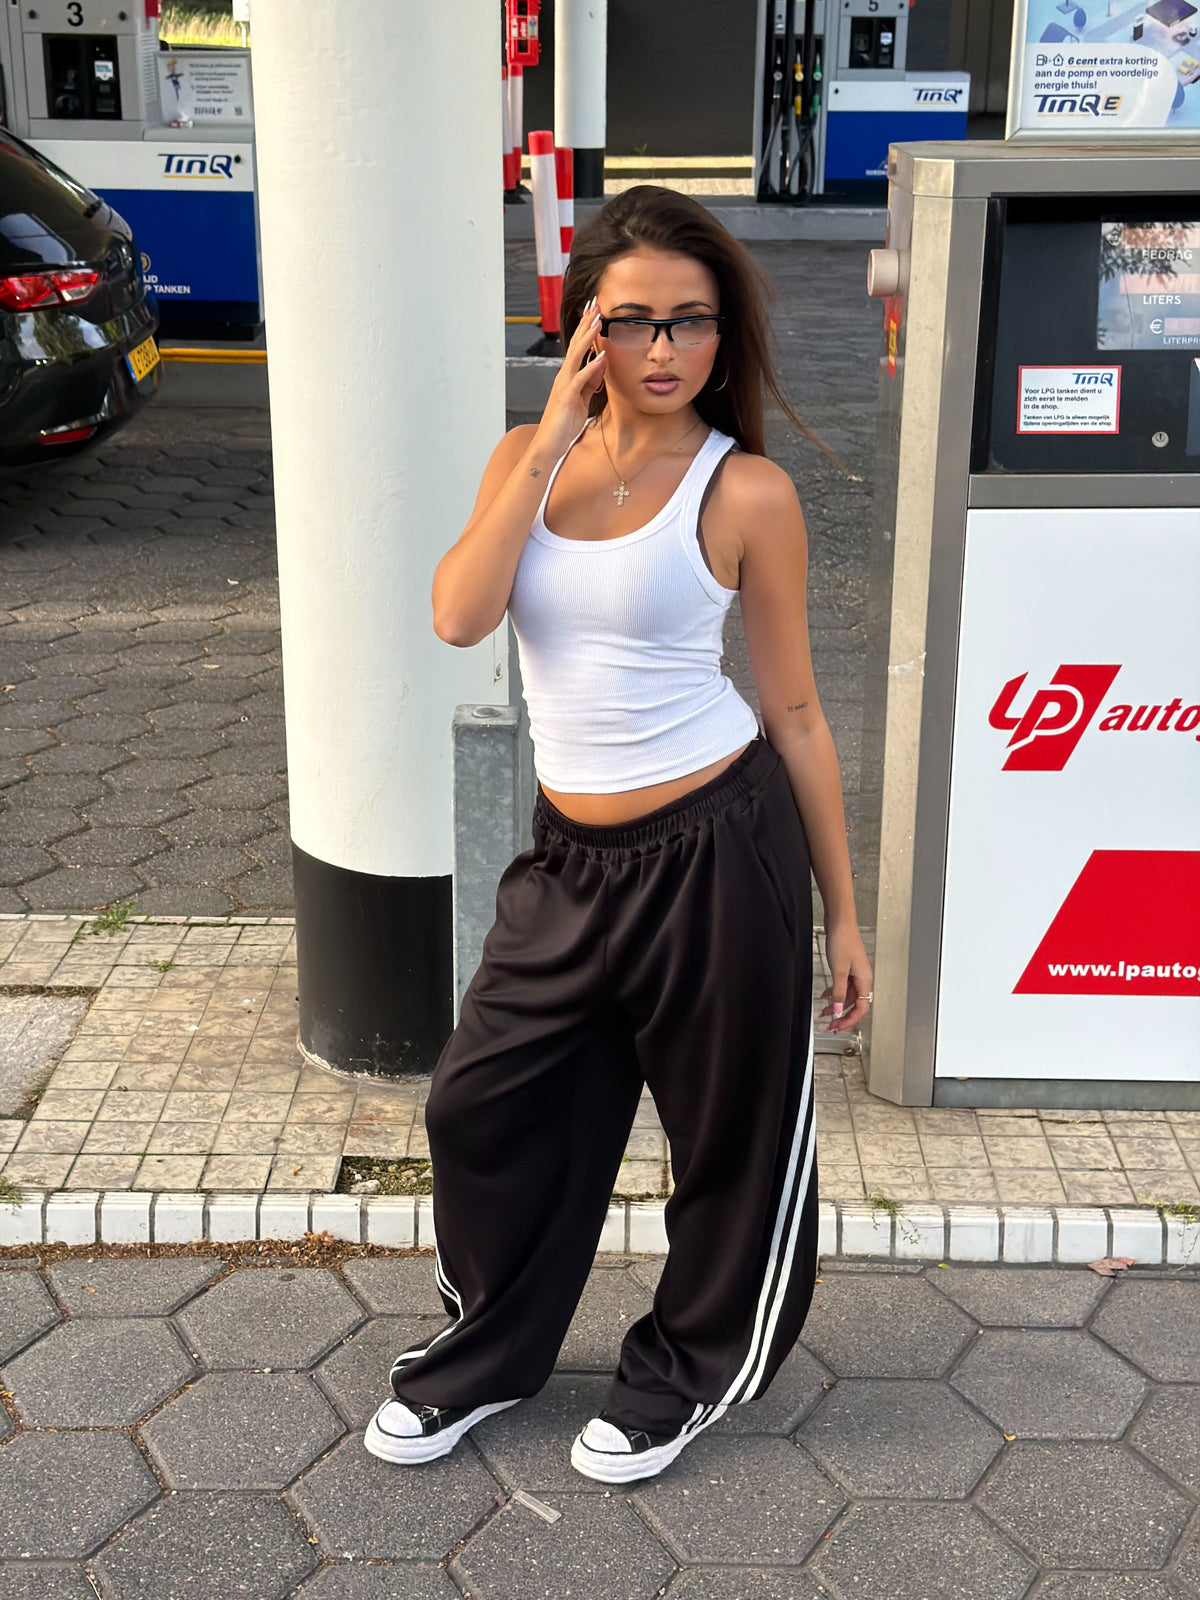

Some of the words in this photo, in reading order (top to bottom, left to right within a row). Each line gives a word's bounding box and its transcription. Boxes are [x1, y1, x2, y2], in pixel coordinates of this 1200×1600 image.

[868, 0, 879, 12] 5
[66, 2, 84, 27] 3
[1067, 57, 1075, 65] 6
[1076, 57, 1098, 65] cent
[1099, 57, 1123, 65] extra
[1125, 57, 1158, 67] korting
[1054, 69, 1066, 77] de
[1067, 70, 1094, 79] pomp
[1110, 69, 1159, 79] voordelige
[1034, 81, 1069, 91] energie
[1071, 81, 1097, 89] thuis!
[1142, 249, 1193, 260] BEDRAG
[153, 284, 191, 294] TANKEN
[1143, 295, 1182, 305] LITERS
[1163, 336, 1200, 345] LITERPR
[1098, 697, 1200, 742] auto
[1048, 960, 1200, 981] www.lpauto
